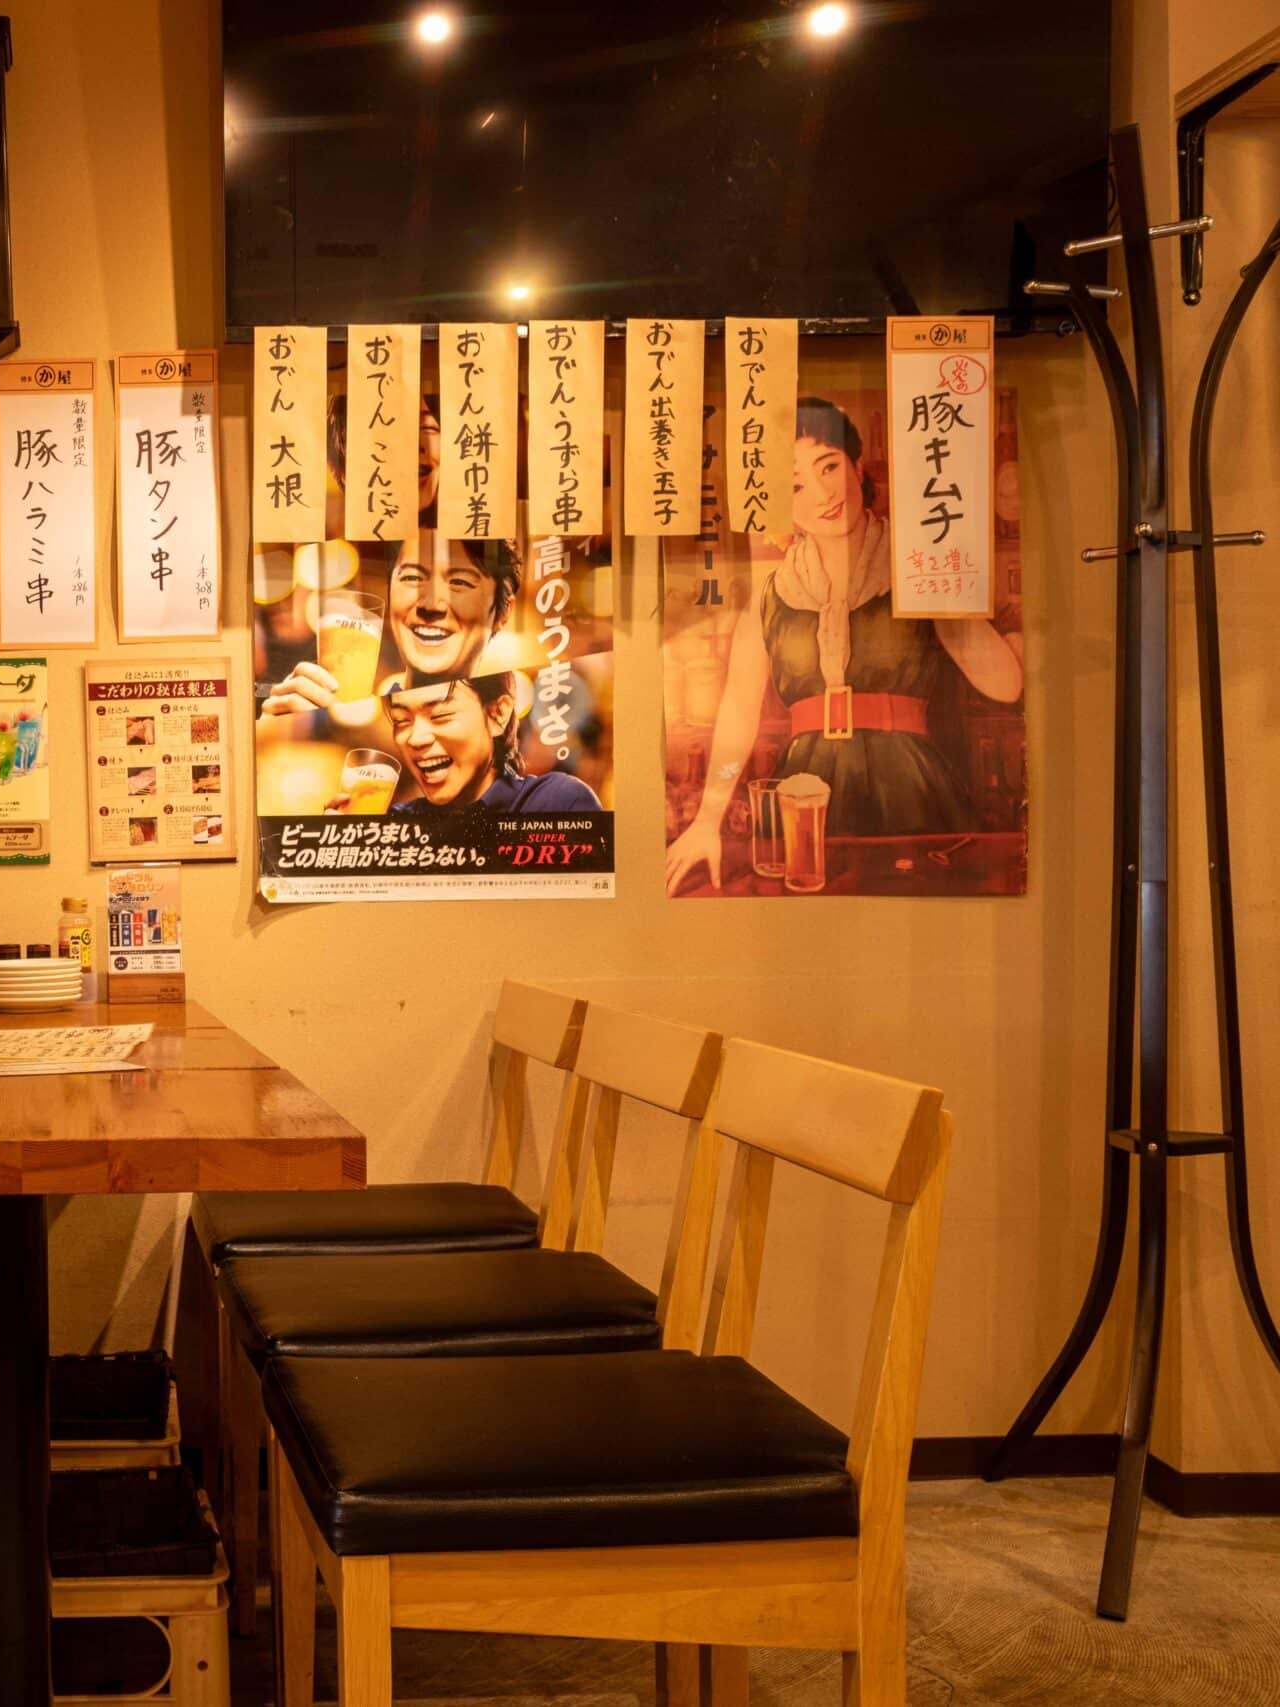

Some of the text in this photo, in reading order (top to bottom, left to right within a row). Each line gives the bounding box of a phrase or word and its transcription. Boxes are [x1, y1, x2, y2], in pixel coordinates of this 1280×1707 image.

[365, 335, 396, 430] おでん
[71, 398, 88, 468] 数量限定
[191, 391, 207, 455] 数量限定
[265, 333, 311, 509] おでん 大根
[906, 391, 975, 545] 豚キムチ
[14, 428, 63, 615] 豚ハラミ串
[135, 429, 187, 592] 豚タン串
[97, 681, 217, 698] こだわりの秘伝製法
[277, 845, 486, 869] この瞬間がたまらない。
[280, 823, 430, 846] ビールがうまい。
[498, 820, 593, 832] THE JAPAN BRAND
[527, 832, 567, 843] SUPER
